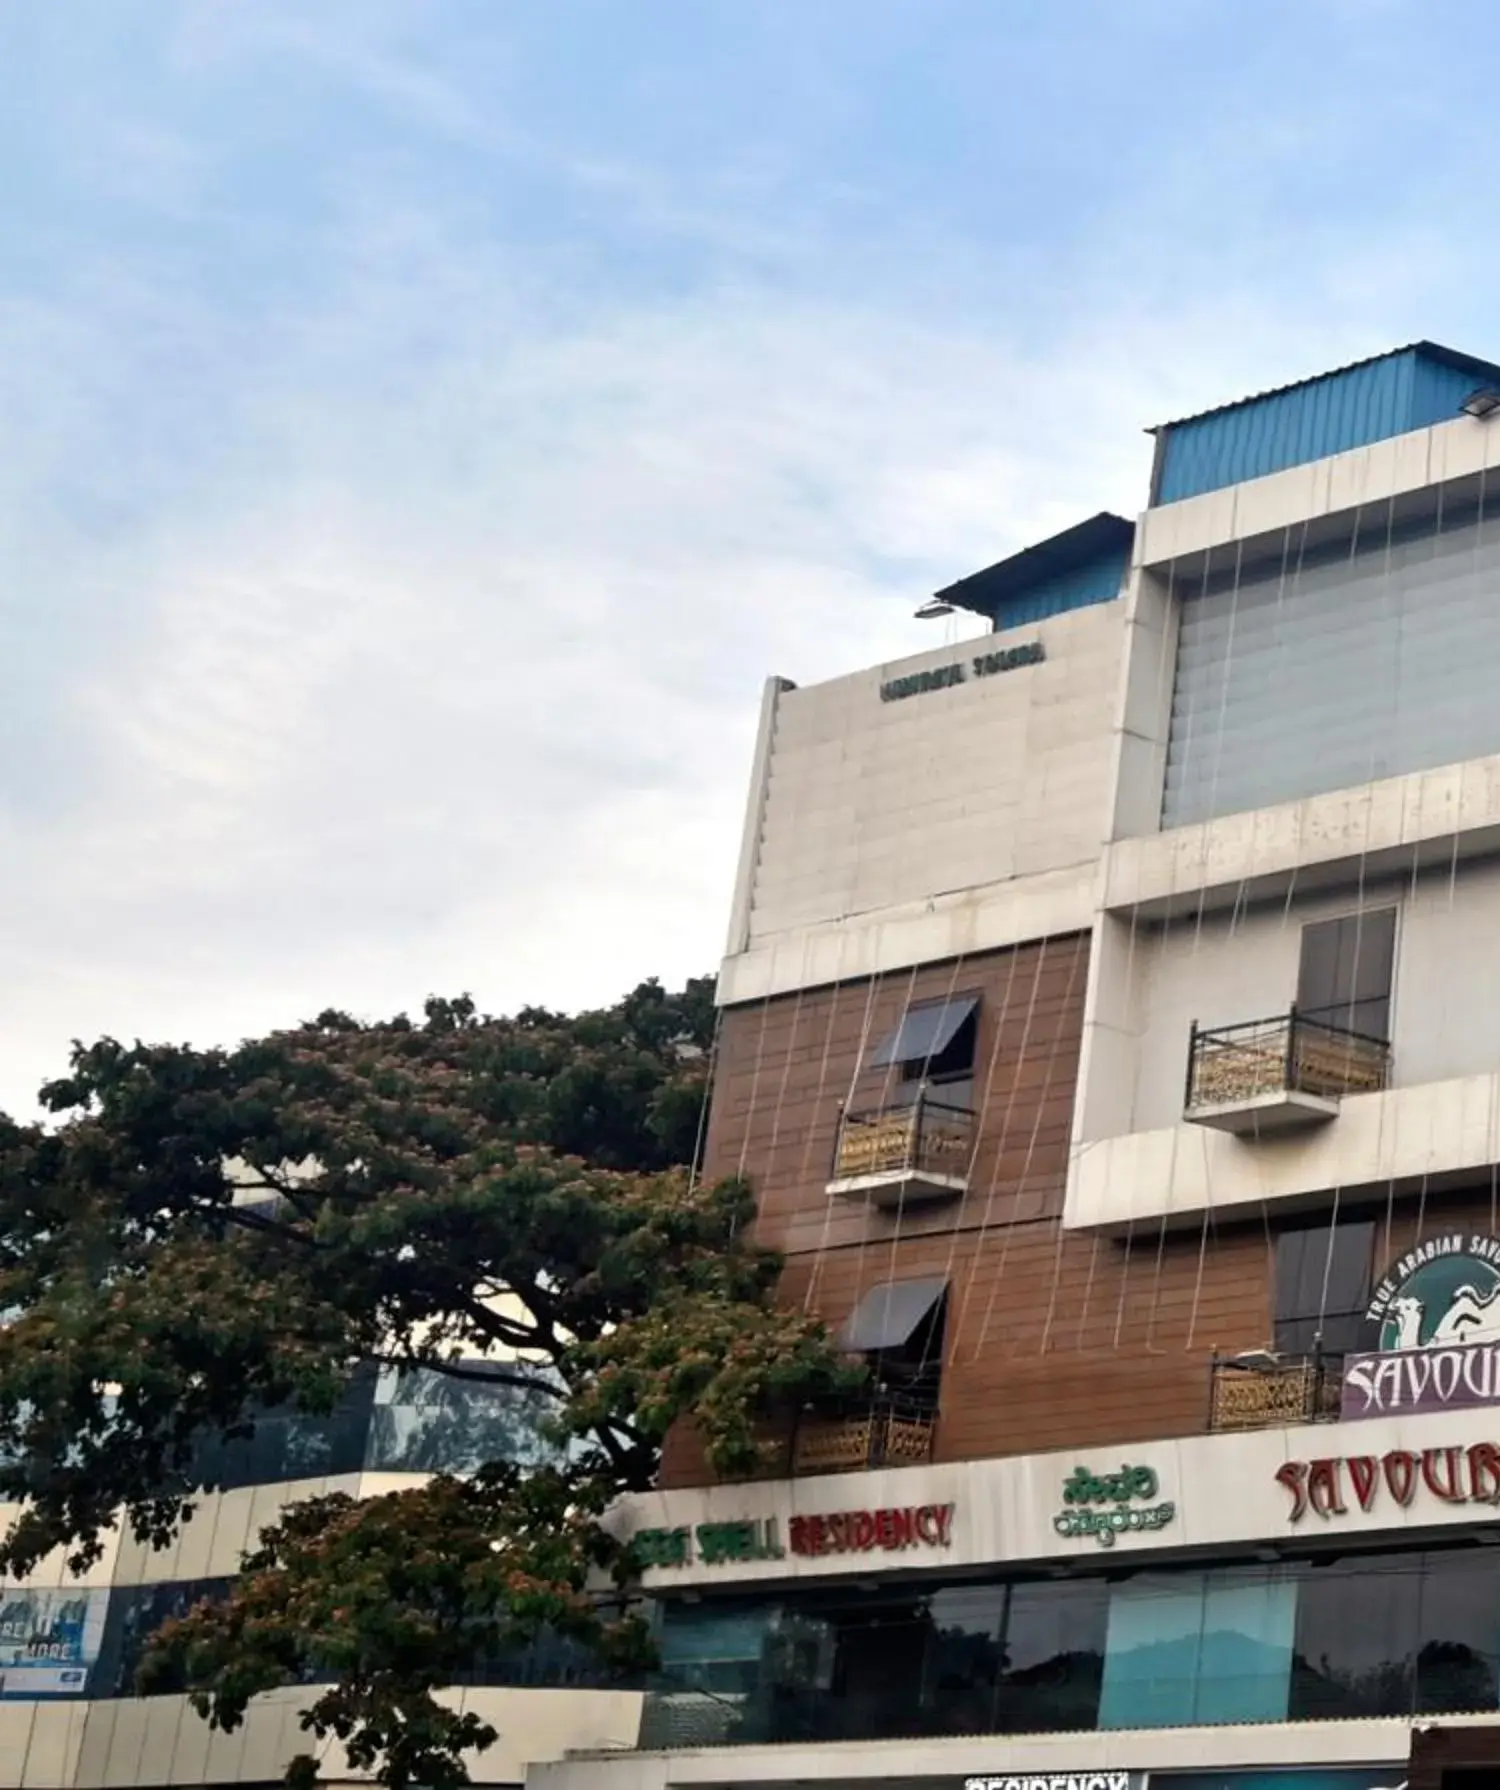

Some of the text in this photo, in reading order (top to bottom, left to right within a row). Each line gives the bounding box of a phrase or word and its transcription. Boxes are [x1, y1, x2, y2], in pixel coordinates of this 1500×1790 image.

[1365, 1277, 1398, 1322] TRUE
[1397, 1234, 1464, 1277] ARABIAN
[789, 1502, 956, 1559] RESIDENCY
